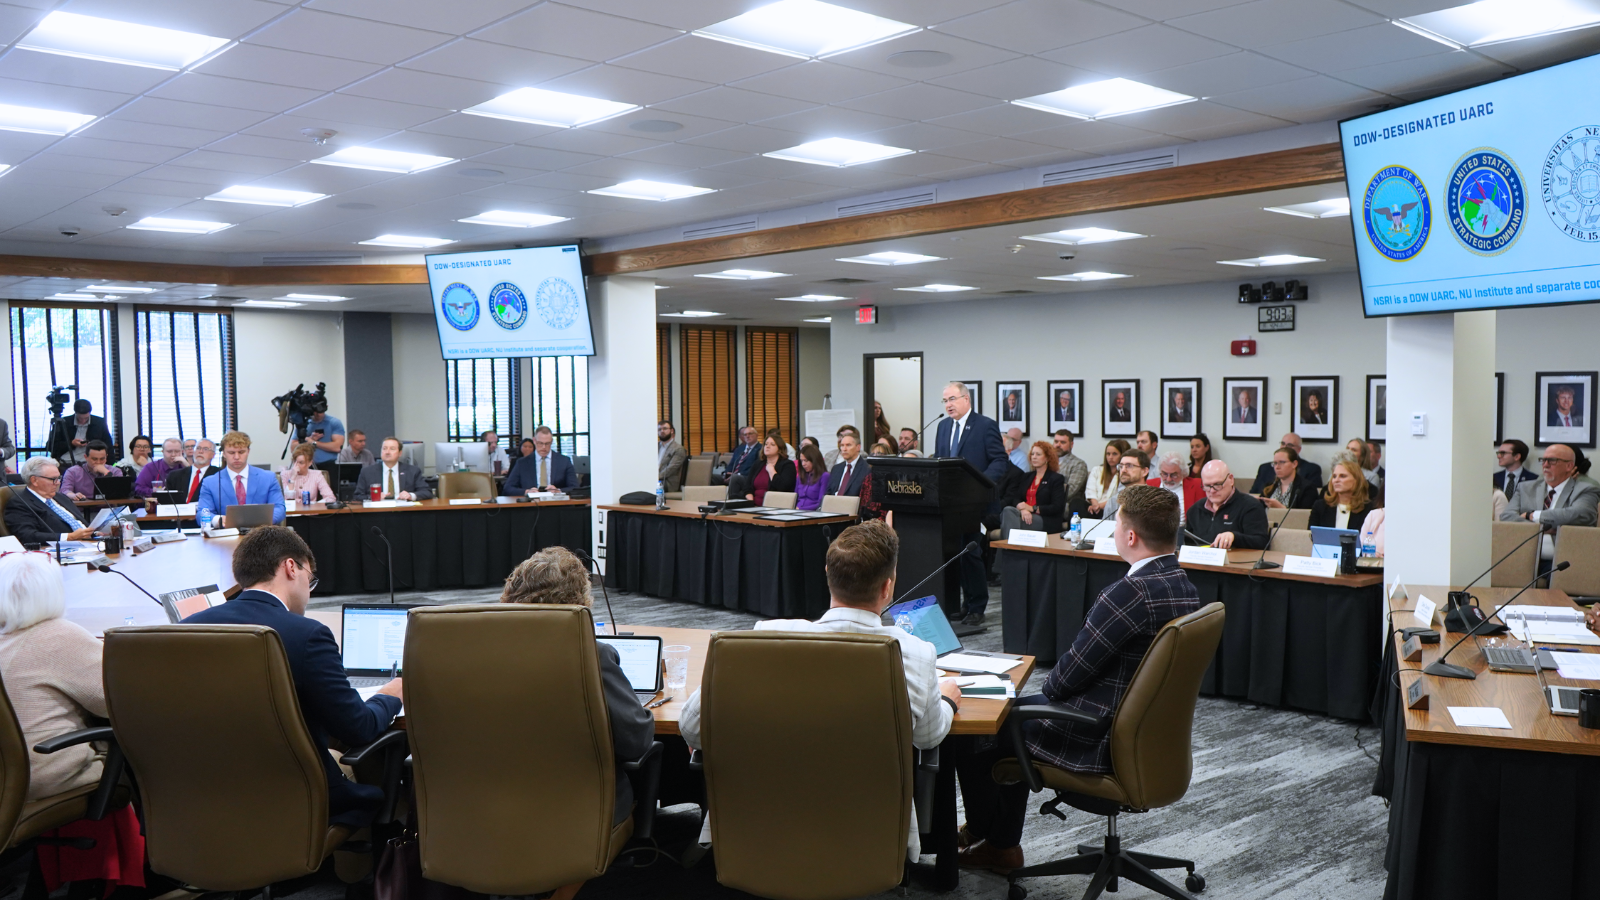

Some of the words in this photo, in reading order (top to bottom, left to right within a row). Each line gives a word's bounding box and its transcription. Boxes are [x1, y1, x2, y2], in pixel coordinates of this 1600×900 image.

[1353, 111, 1456, 147] DOW-DESIGNATED
[1459, 101, 1494, 121] UARC
[1453, 157, 1478, 185] UNITED
[1482, 155, 1512, 177] STATES
[1543, 133, 1574, 203] UNIVERSITAS
[1364, 167, 1401, 209] DEPARTMENT
[1402, 169, 1413, 180] OF
[1414, 178, 1427, 200] WAR
[1371, 233, 1387, 253] UNITED
[1387, 250, 1406, 258] STATES
[1405, 248, 1413, 257] OF
[1413, 226, 1429, 253] AMERICA
[1453, 217, 1492, 249] STRATEGIC
[1493, 208, 1522, 248] COMMAND
[1563, 224, 1586, 240] FEB.
[434, 259, 492, 270] DOW-DESIGNATED
[493, 258, 512, 266] UARC
[1373, 295, 1393, 306] NSRI
[1393, 294, 1402, 304] is
[1402, 296, 1408, 304] a
[1409, 292, 1429, 303] DOW
[1430, 290, 1458, 301] UARC,
[1459, 288, 1472, 299] NU
[1474, 286, 1513, 298] Institute
[1515, 283, 1533, 295] and
[1535, 280, 1581, 295] separate
[887, 480, 922, 494] Nebraska
